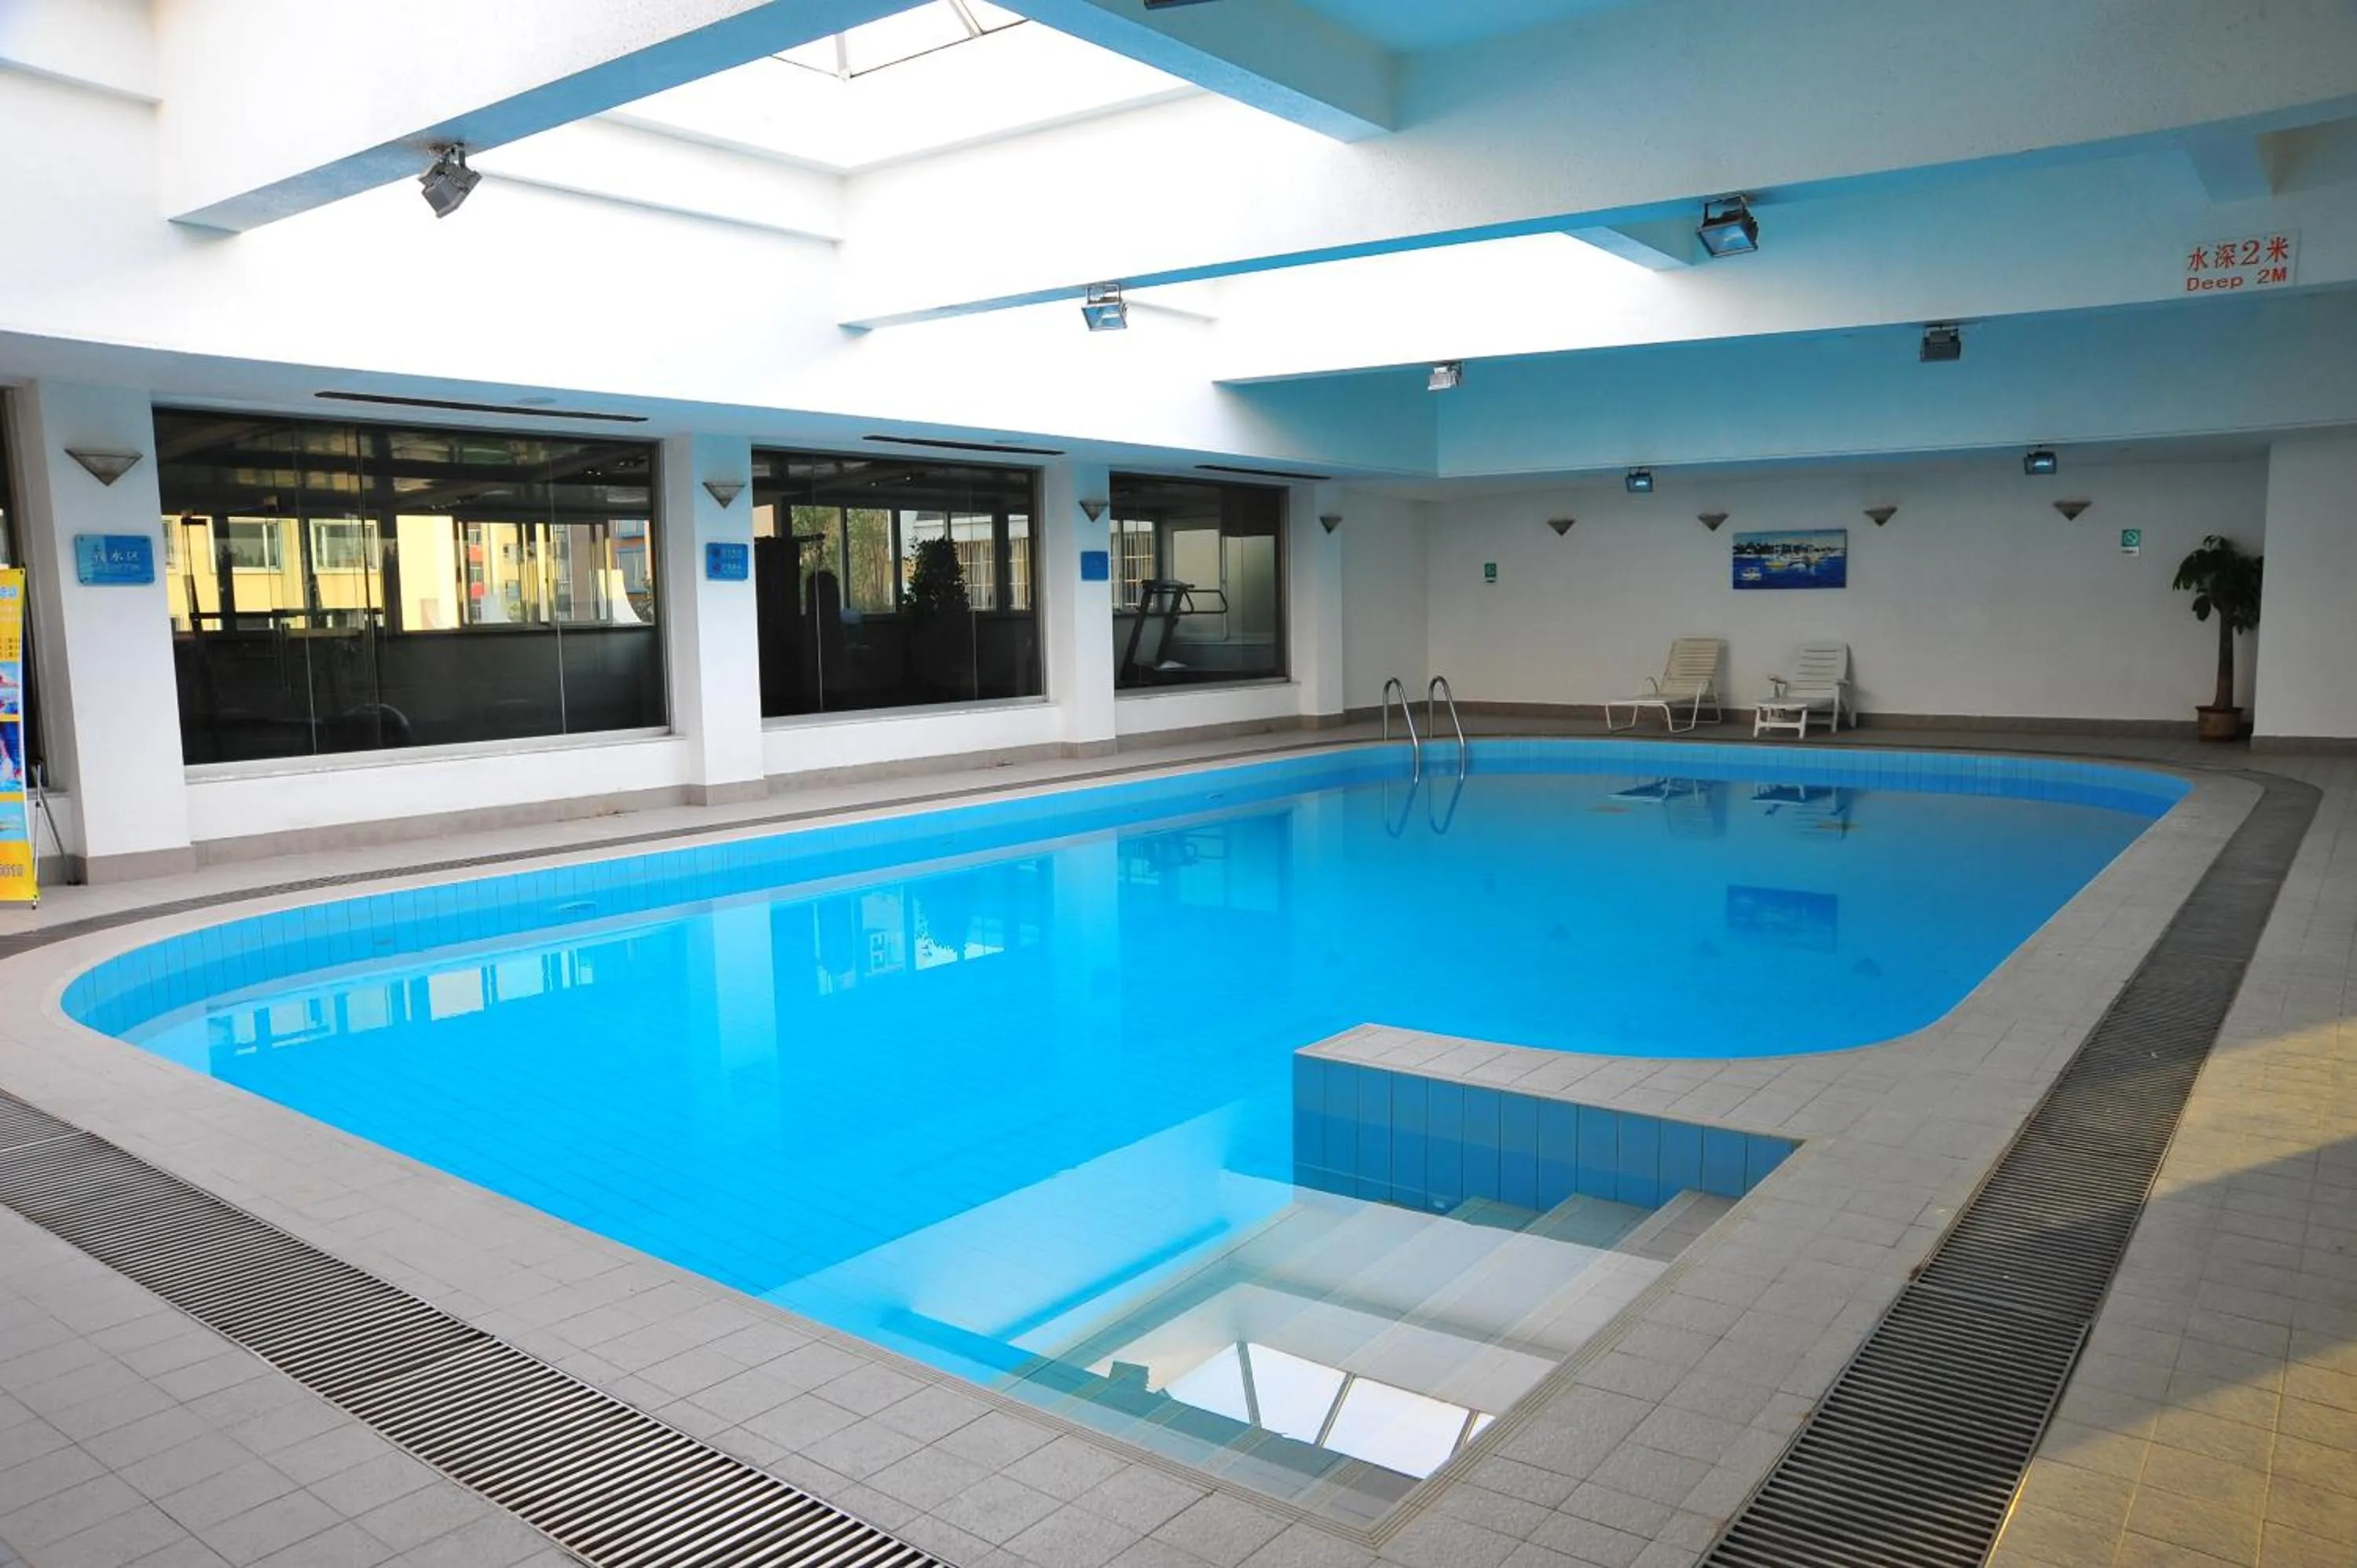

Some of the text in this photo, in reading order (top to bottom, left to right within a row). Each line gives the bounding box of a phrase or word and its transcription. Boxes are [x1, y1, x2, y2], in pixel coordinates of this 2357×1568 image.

[2187, 237, 2288, 272] 水深2米
[2187, 267, 2287, 291] Deep 2M
